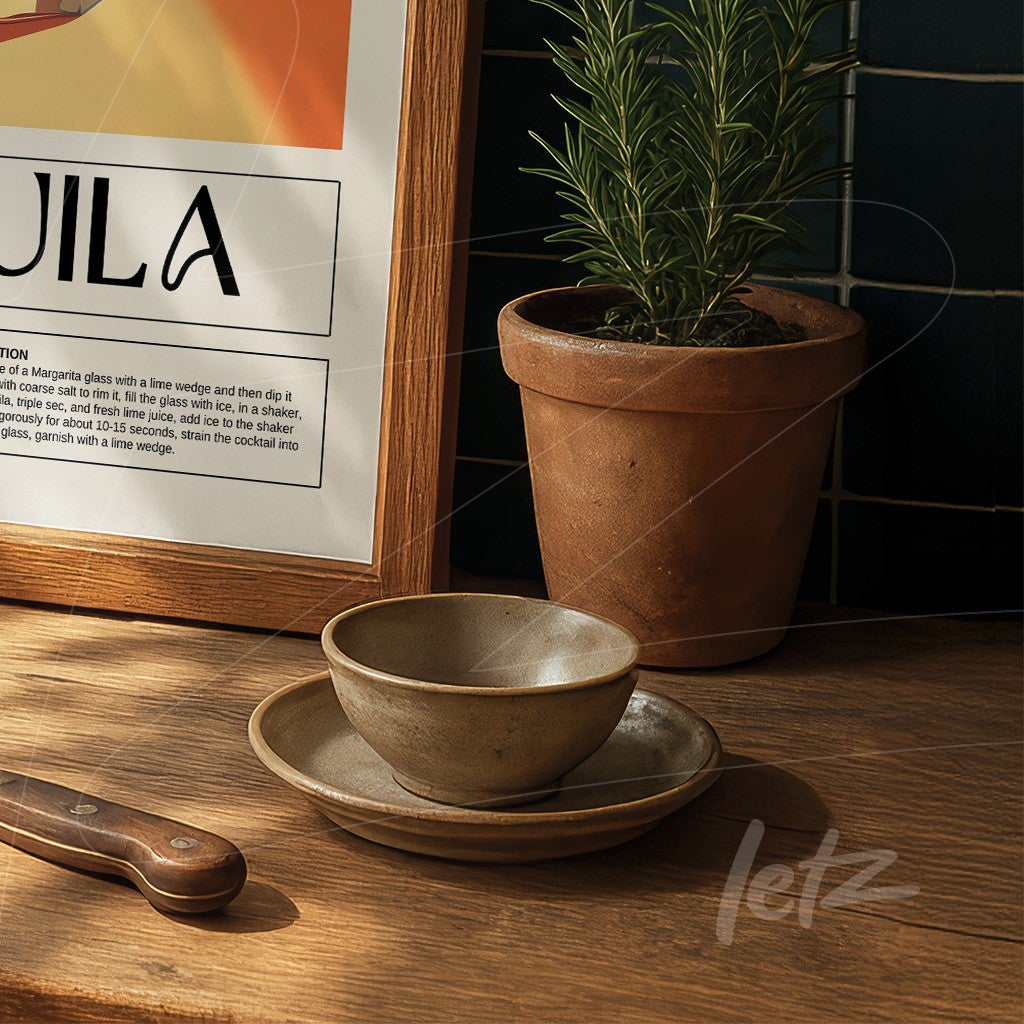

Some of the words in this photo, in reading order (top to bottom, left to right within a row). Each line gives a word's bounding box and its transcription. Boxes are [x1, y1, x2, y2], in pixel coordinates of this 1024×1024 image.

[8, 364, 20, 375] of
[21, 367, 29, 376] a
[31, 366, 82, 382] Margarita
[83, 371, 112, 385] glass
[115, 374, 137, 387] with
[139, 379, 147, 388] a
[149, 377, 173, 390] lime
[174, 381, 211, 396] wedge
[213, 385, 235, 397] and
[237, 386, 262, 399] then
[265, 388, 282, 403] dip
[285, 390, 292, 402] it
[18, 382, 55, 395] coarse
[57, 384, 77, 397] salt
[79, 387, 90, 398] to
[92, 387, 110, 400] rim
[112, 388, 121, 403] it,
[124, 390, 137, 403] fill
[138, 391, 157, 405] the
[159, 394, 188, 408] glass
[190, 397, 213, 410] with
[215, 398, 235, 414] ice,
[238, 401, 248, 414] in
[250, 405, 259, 415] a
[261, 404, 302, 421] shaker,
[16, 396, 43, 410] triple
[45, 400, 67, 413] sec,
[70, 402, 91, 414] and
[93, 403, 120, 417] fresh
[122, 406, 145, 420] lime
[147, 408, 177, 424] juice,
[179, 413, 201, 425] add
[203, 414, 220, 427] ice
[222, 417, 233, 429] to
[235, 417, 254, 430] the
[255, 420, 294, 434] shaker
[45, 413, 60, 427] for
[62, 416, 93, 430] about
[95, 420, 127, 434] 10-15
[128, 425, 178, 440] seconds,
[180, 429, 211, 442] strain
[213, 430, 232, 444] the
[234, 435, 276, 448] cocktail
[278, 437, 299, 451] into
[0, 425, 31, 441] glass,
[34, 431, 74, 444] garnish
[76, 433, 99, 446] with
[100, 437, 108, 447] a
[111, 436, 134, 450] lime
[135, 441, 174, 456] wedge.
